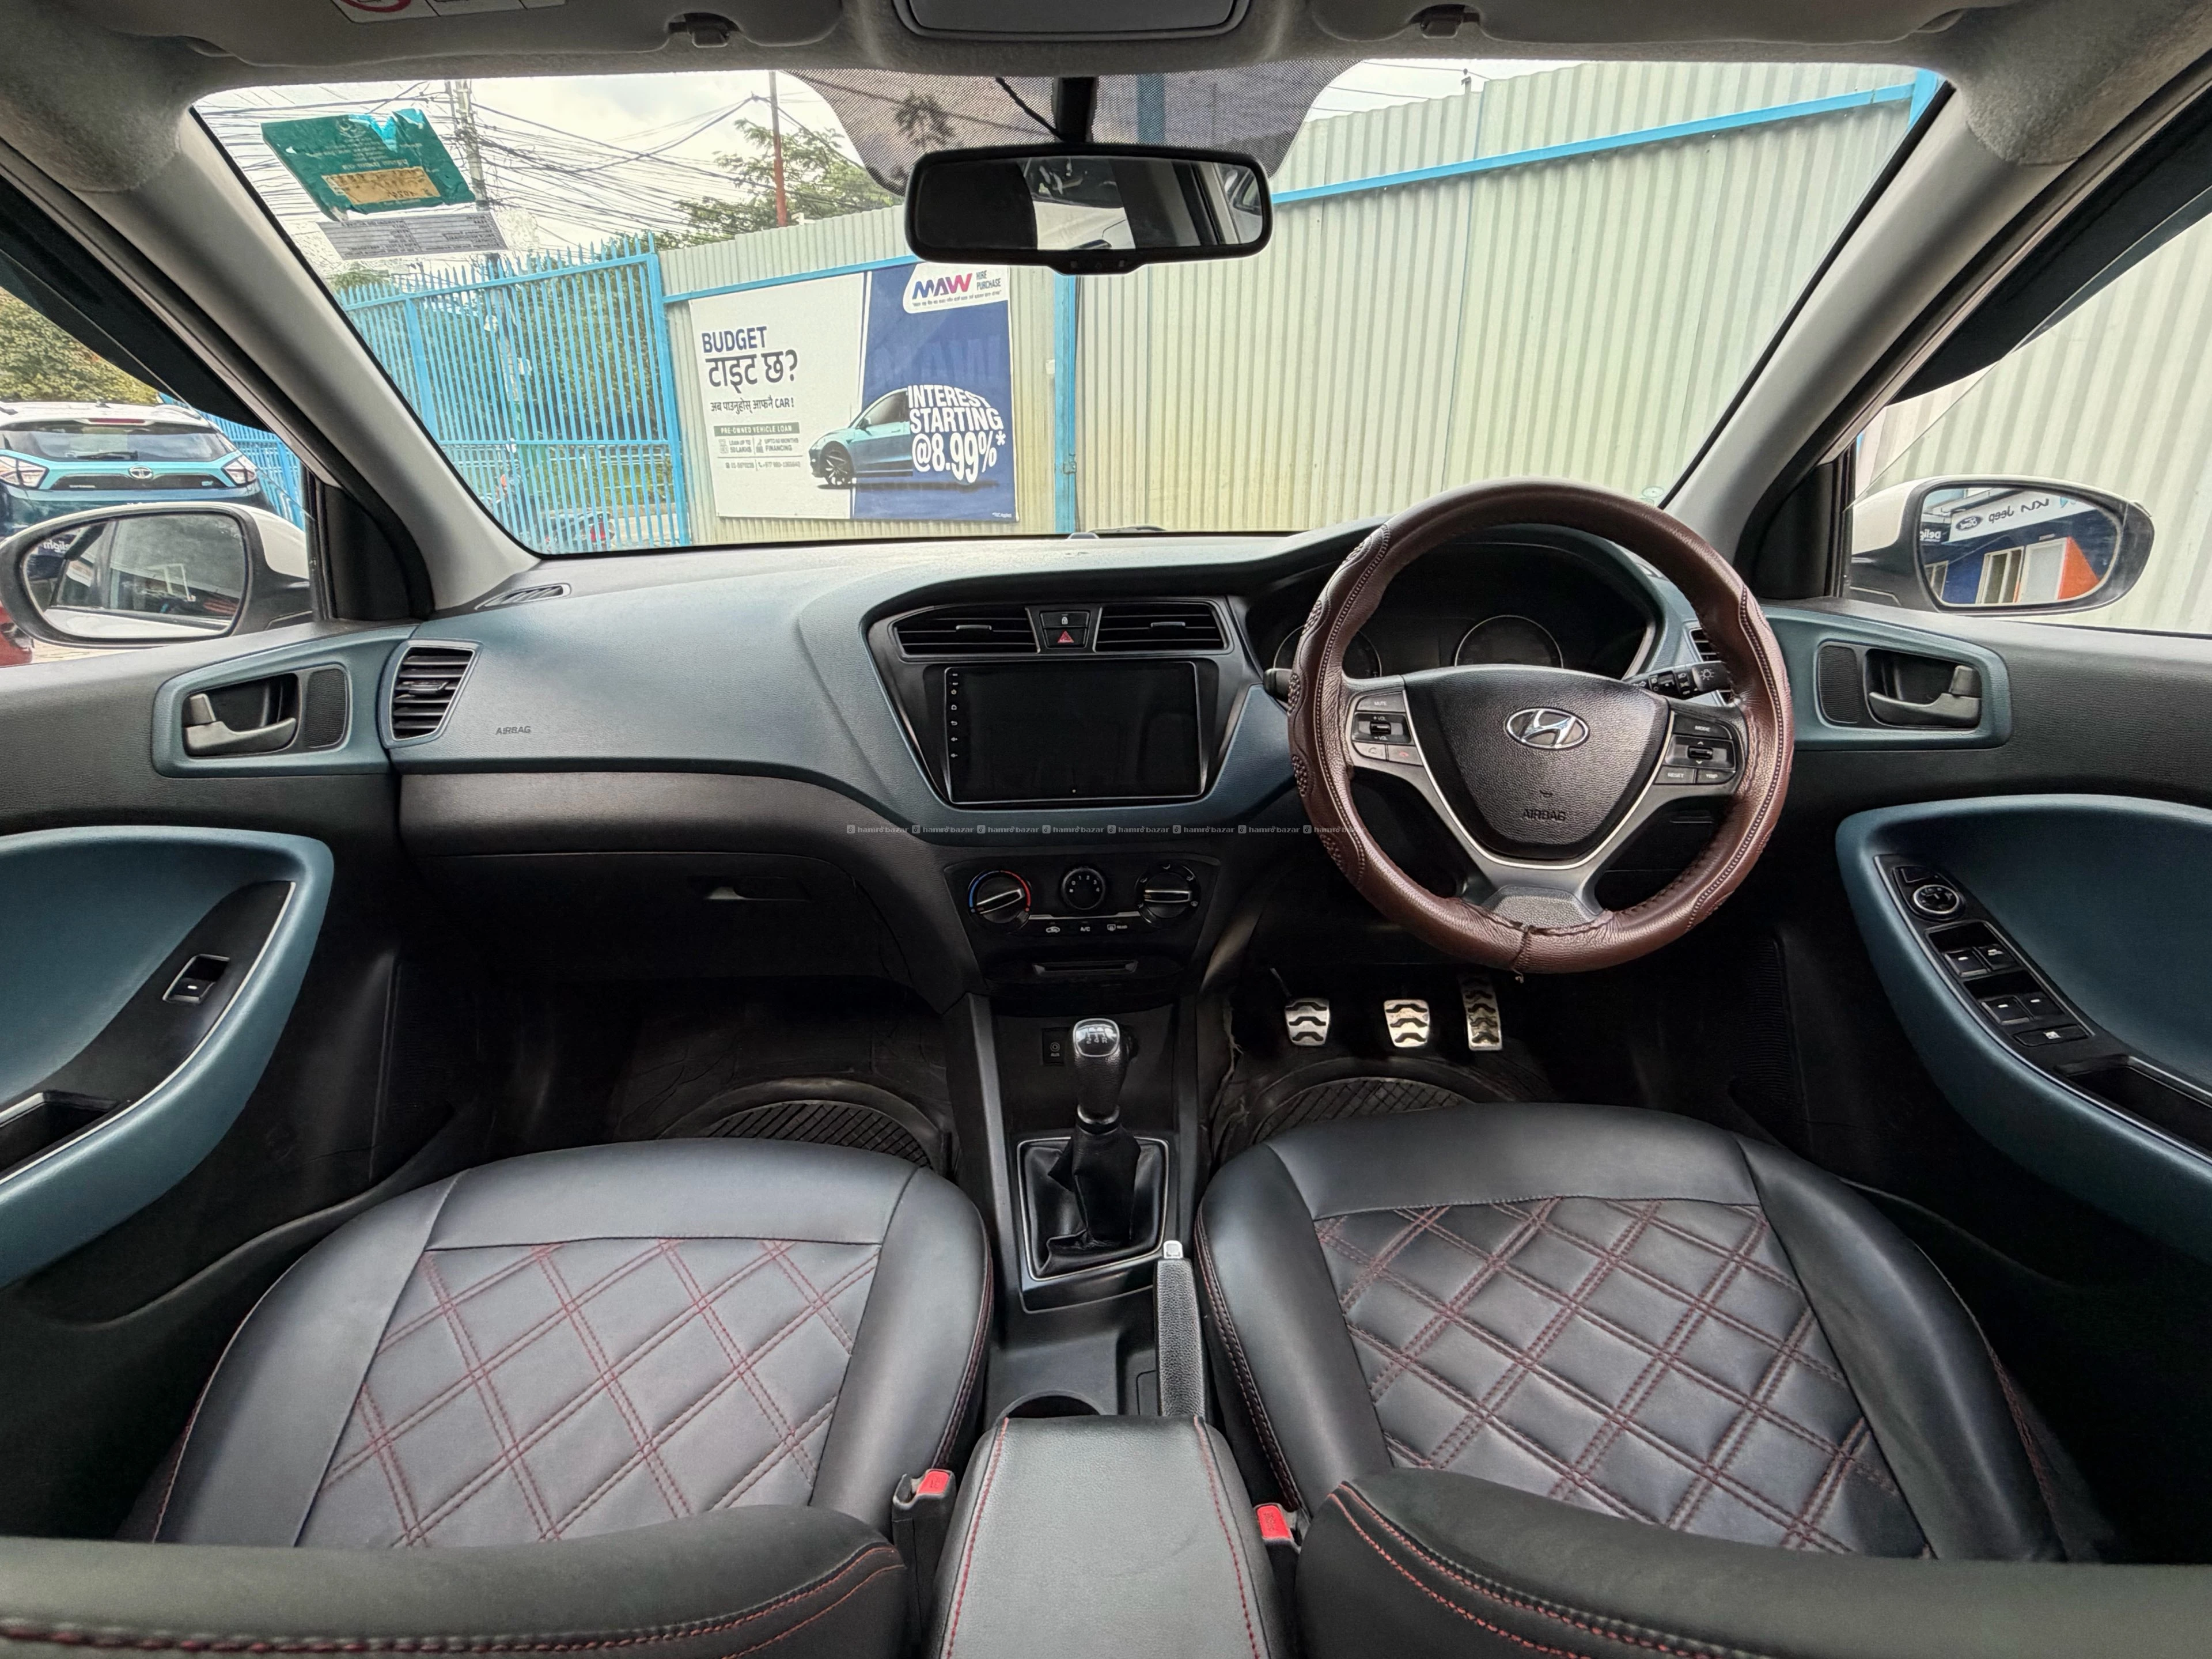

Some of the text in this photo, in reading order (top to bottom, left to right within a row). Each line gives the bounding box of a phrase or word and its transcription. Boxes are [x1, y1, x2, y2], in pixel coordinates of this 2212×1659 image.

[912, 273, 972, 300] MAW
[976, 278, 1001, 290] PURCHASE
[702, 326, 767, 353] BUDGET
[705, 349, 798, 393] टाइट छ?
[710, 402, 722, 411] अब
[907, 384, 991, 408] INTEREST
[910, 407, 1004, 433] STARTING
[495, 726, 531, 735] AIRBAG
[1523, 809, 1566, 821] AIRBAG
